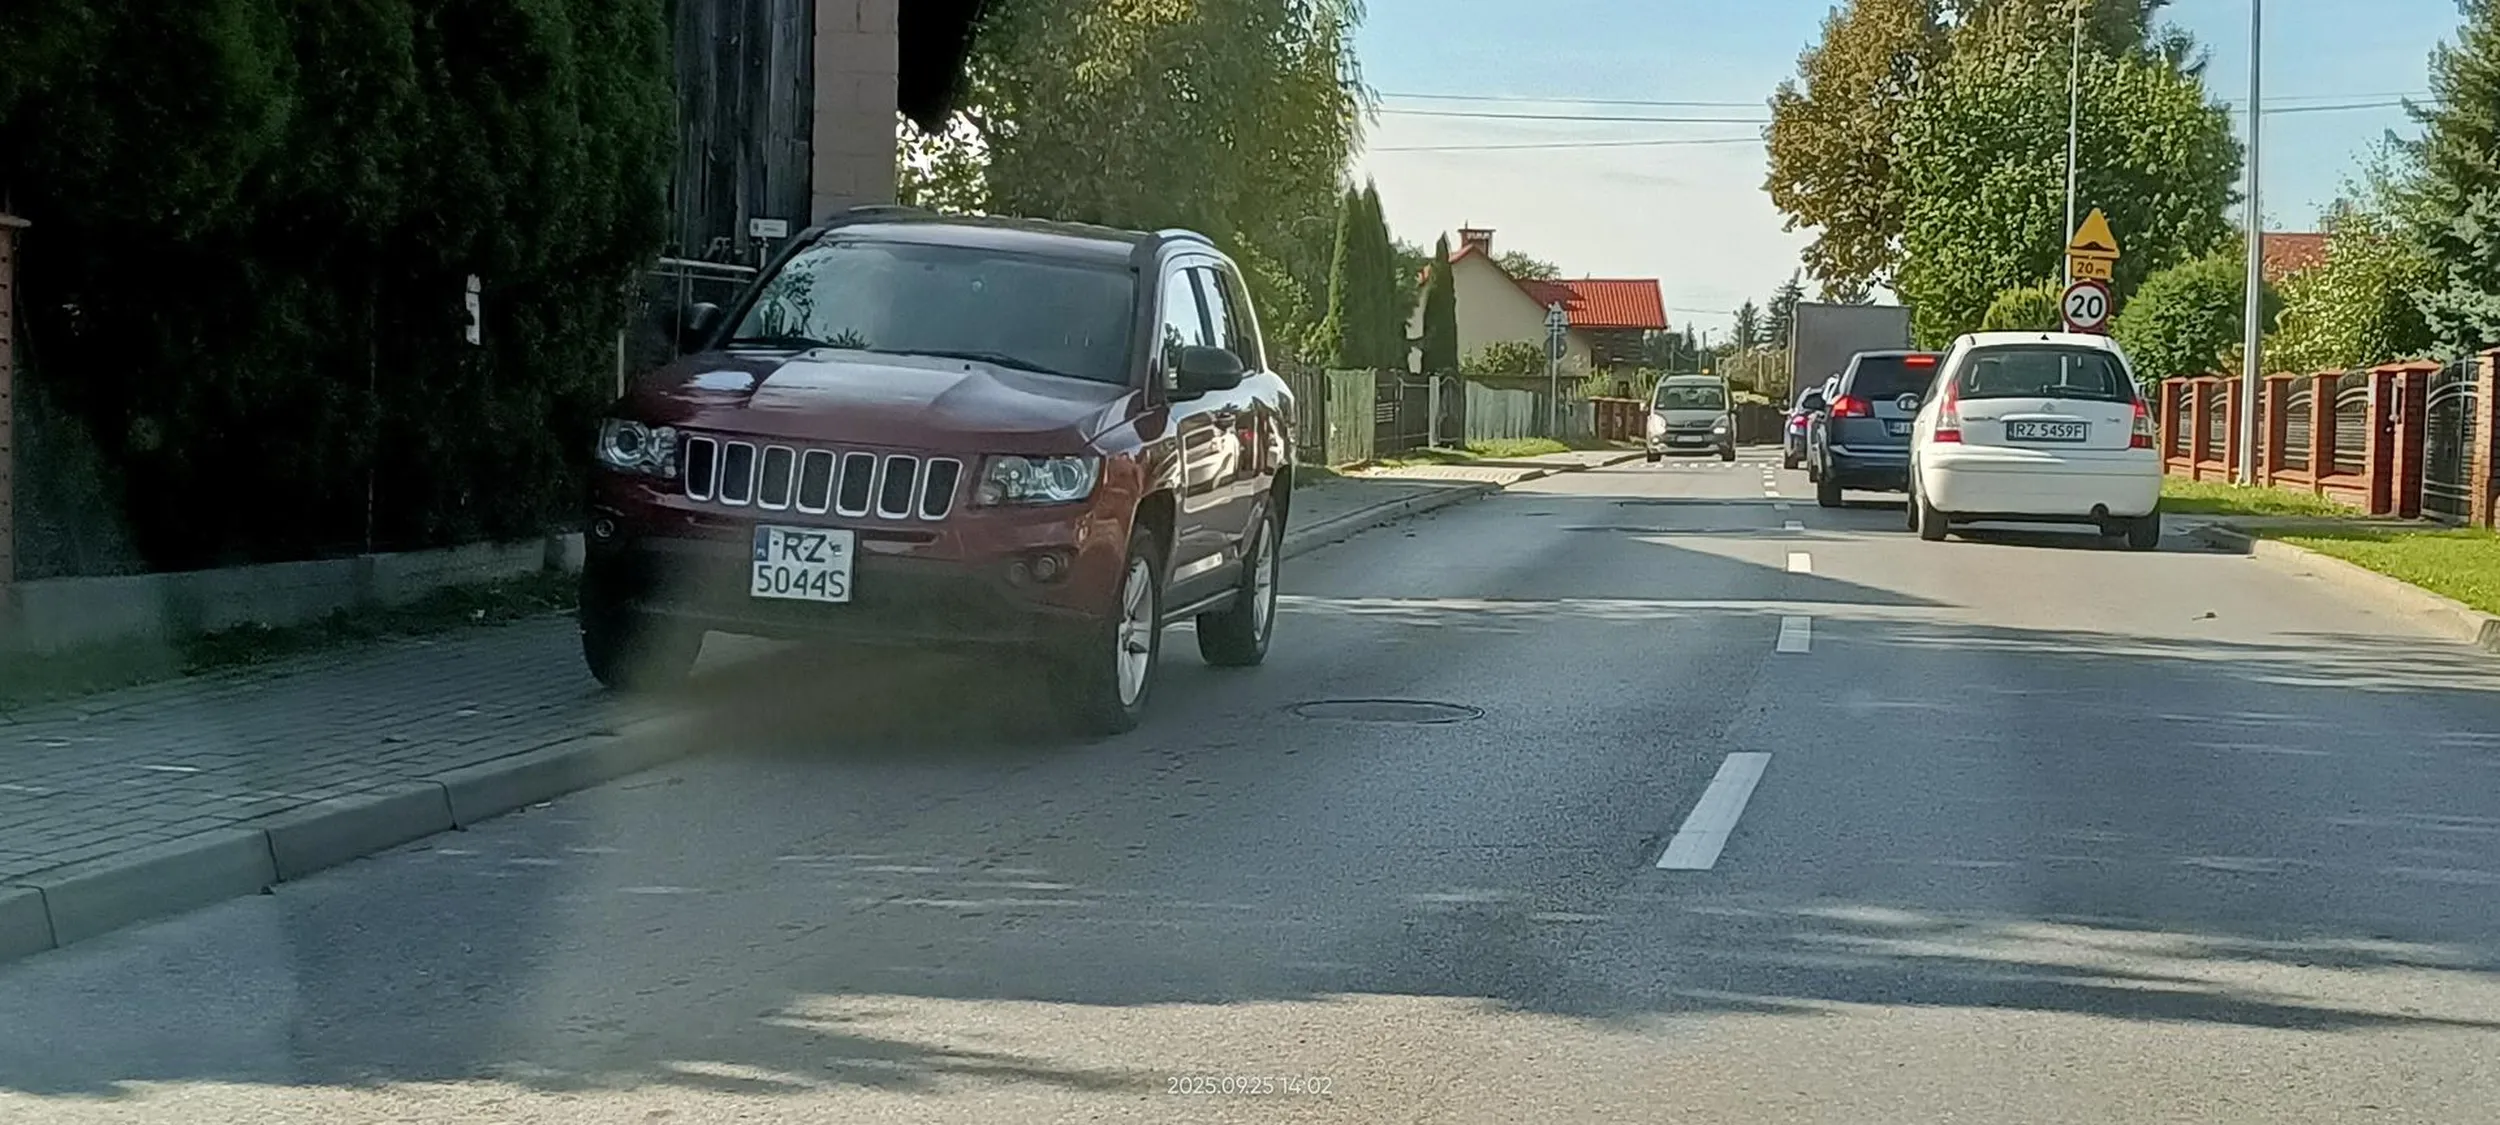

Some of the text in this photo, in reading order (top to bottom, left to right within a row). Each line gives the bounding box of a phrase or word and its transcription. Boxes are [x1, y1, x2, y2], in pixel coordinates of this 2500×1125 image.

[2077, 262, 2093, 274] 20
[2070, 294, 2103, 318] 20
[2016, 424, 2081, 438] RZ 5459F
[782, 531, 827, 563] RZ
[757, 565, 845, 597] 5044S
